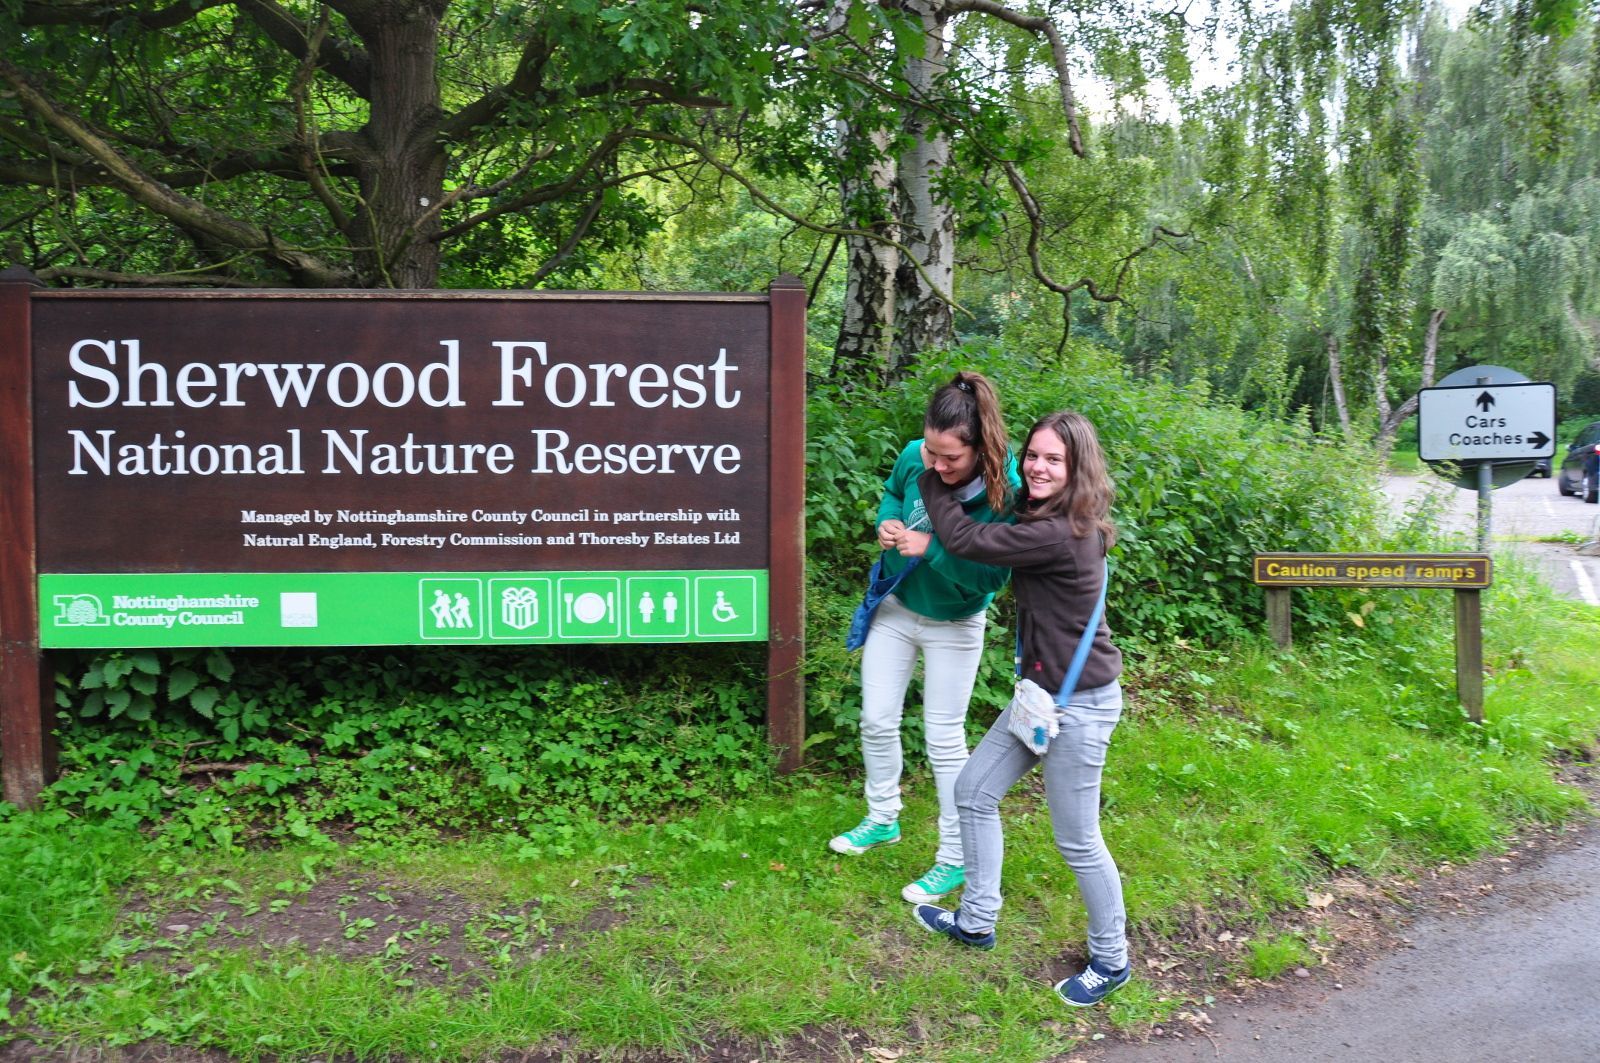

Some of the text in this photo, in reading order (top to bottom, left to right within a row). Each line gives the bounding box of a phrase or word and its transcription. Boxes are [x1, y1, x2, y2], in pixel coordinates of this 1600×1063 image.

[68, 338, 742, 410] Sherwood Forest
[1465, 415, 1507, 430] Cars
[1449, 432, 1524, 448] Coaches
[67, 428, 742, 477] National Nature Reserve
[240, 508, 741, 526] Managed by Nottinghamshire County Council in partnership with
[242, 531, 741, 550] Natural England, Forestry Commission and Thoresby Estates Ltd
[1266, 562, 1477, 581] Caution speed ramps
[112, 594, 260, 611] Nottinghamshire
[112, 611, 245, 629] County Council
